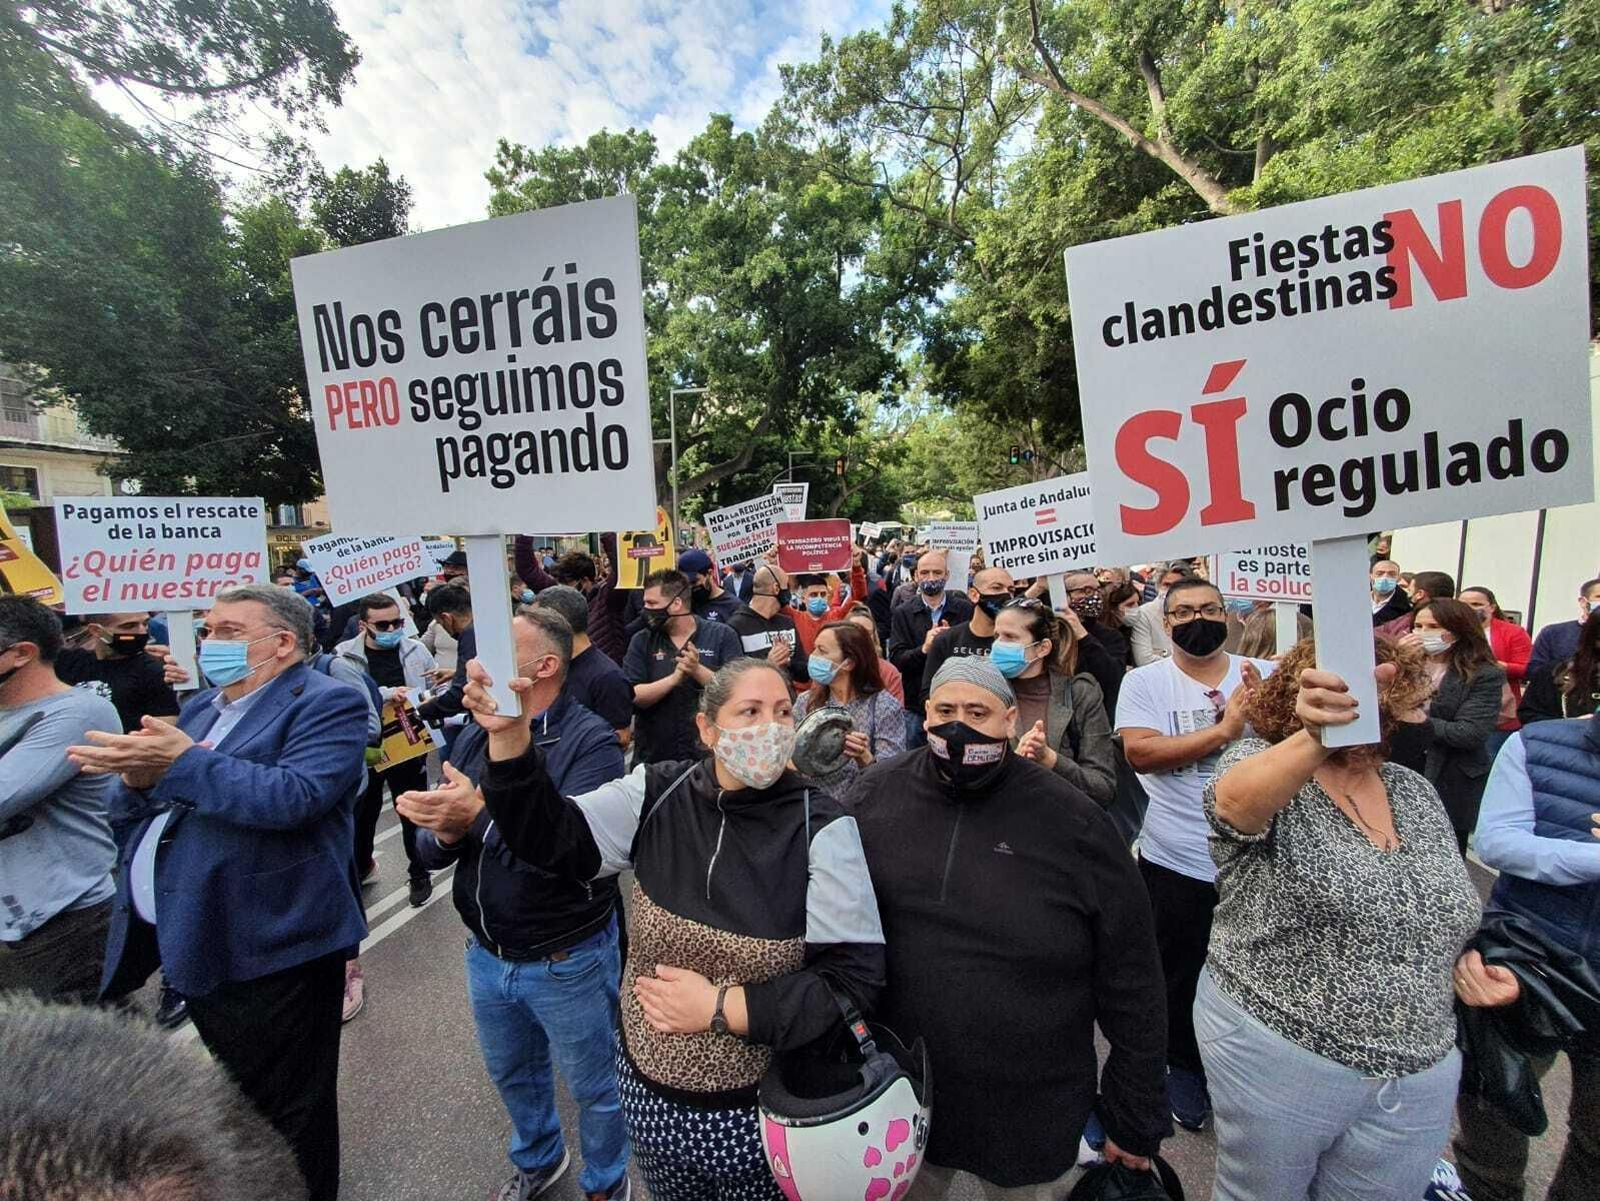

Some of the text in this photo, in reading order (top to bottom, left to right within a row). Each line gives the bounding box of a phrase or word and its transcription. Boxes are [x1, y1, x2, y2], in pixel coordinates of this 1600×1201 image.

[1228, 218, 1396, 282] Fiestas
[1384, 184, 1563, 310] NO
[312, 262, 618, 373] Nos cerráis
[1101, 263, 1398, 347] clandestinas
[325, 354, 625, 431] PERO seguimos
[1268, 378, 1411, 449] Ocio
[435, 411, 630, 492] pagando
[1114, 358, 1256, 536] SÍ
[1273, 418, 1570, 518] regulado
[62, 503, 258, 524] Pagamos el rescate
[709, 514, 724, 526] NO
[739, 495, 783, 516] REDUCCIÓN
[712, 524, 723, 533] DE
[724, 521, 735, 530] LA
[736, 506, 785, 526] PRESTACIÓN
[983, 501, 1018, 520] Junta
[1020, 496, 1036, 509] de
[108, 523, 221, 540] de la banca
[744, 518, 773, 533] ERTE
[309, 537, 360, 554] Pagam
[336, 547, 351, 558] de
[351, 544, 362, 553] la
[716, 536, 750, 553] SUELDOS
[739, 538, 771, 552] PARA LOS
[993, 552, 1035, 569] Cierre
[1037, 548, 1059, 563] sin
[65, 548, 261, 579] ¿Quién paga
[325, 540, 421, 585] ¿Quién paga
[337, 579, 352, 595] el
[356, 555, 422, 588] nuestro?
[1238, 559, 1311, 577] es parte
[82, 578, 111, 602] el
[1230, 571, 1313, 596] la soluc
